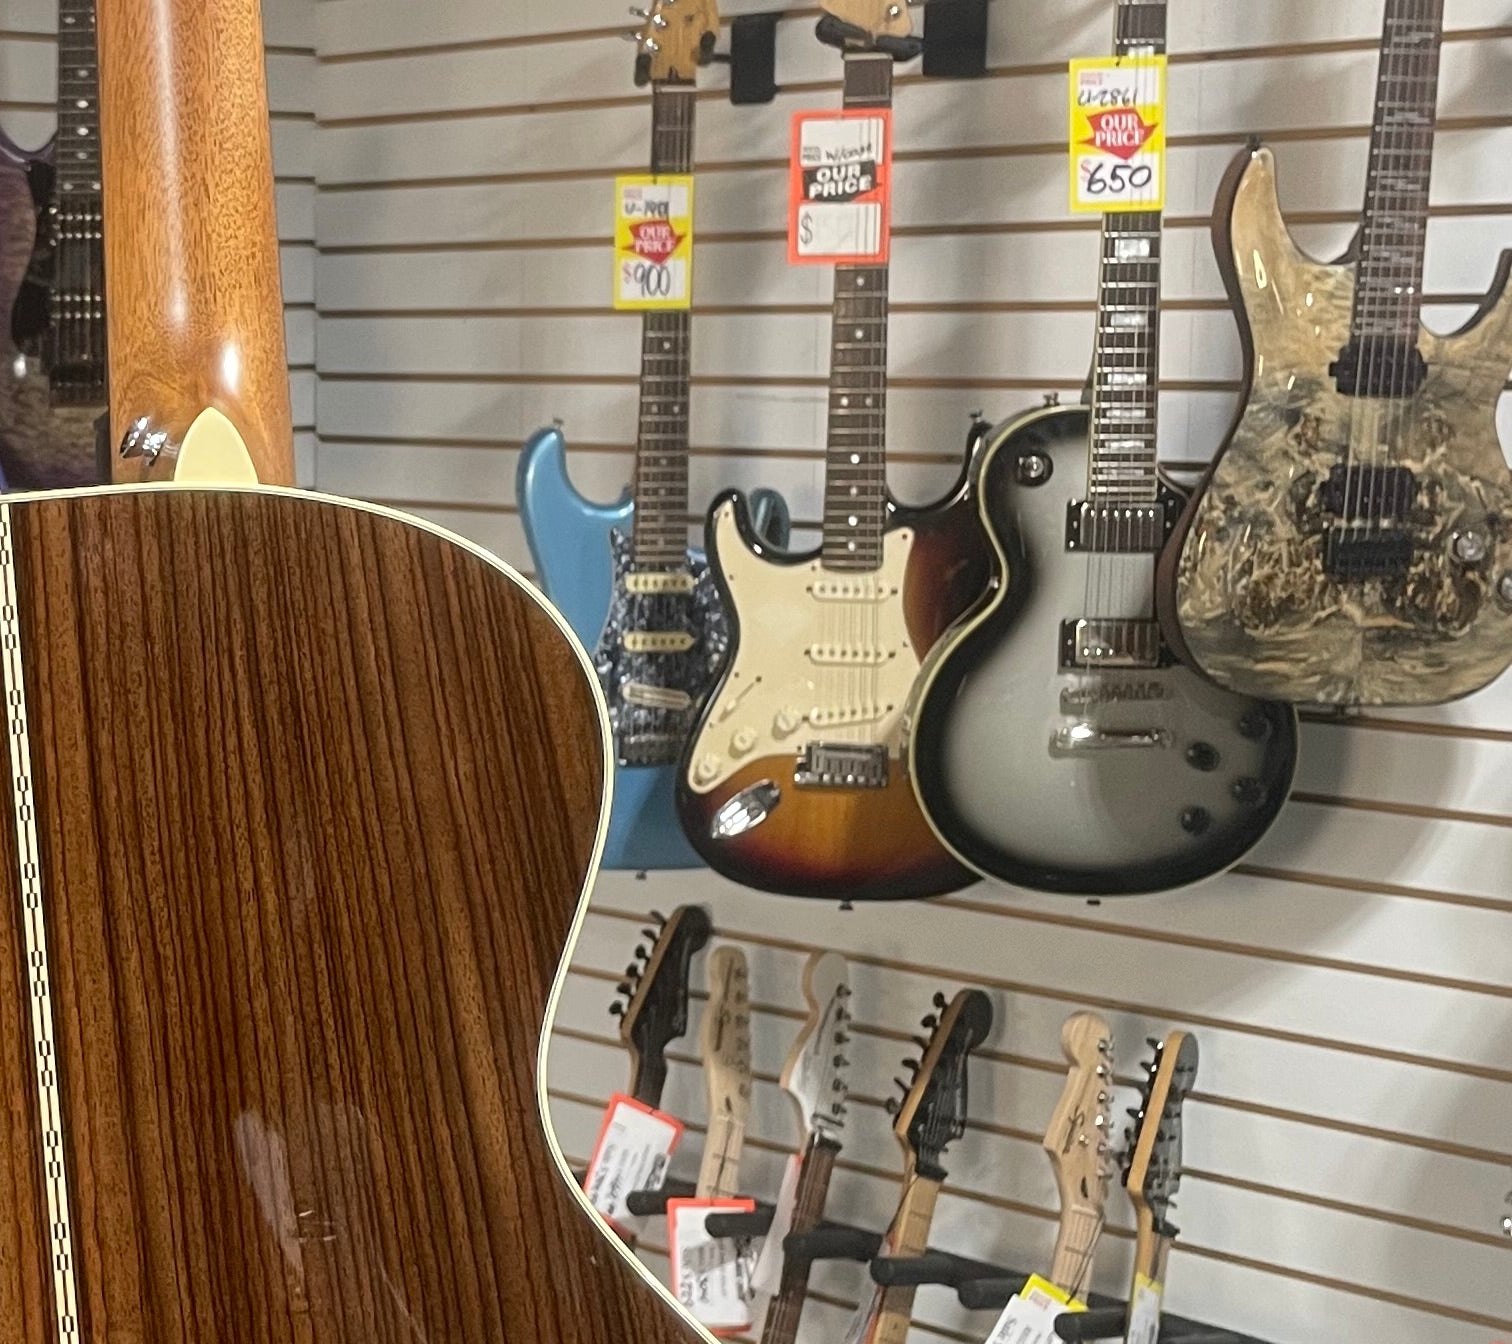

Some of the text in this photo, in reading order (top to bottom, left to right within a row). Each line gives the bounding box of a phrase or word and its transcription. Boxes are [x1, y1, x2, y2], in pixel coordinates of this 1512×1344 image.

[1100, 113, 1139, 132] OUR
[1094, 128, 1145, 148] PRICE
[816, 163, 861, 184] OUR
[808, 174, 872, 200] PRICE
[639, 224, 671, 239] OUR
[635, 238, 675, 254] PRICE
